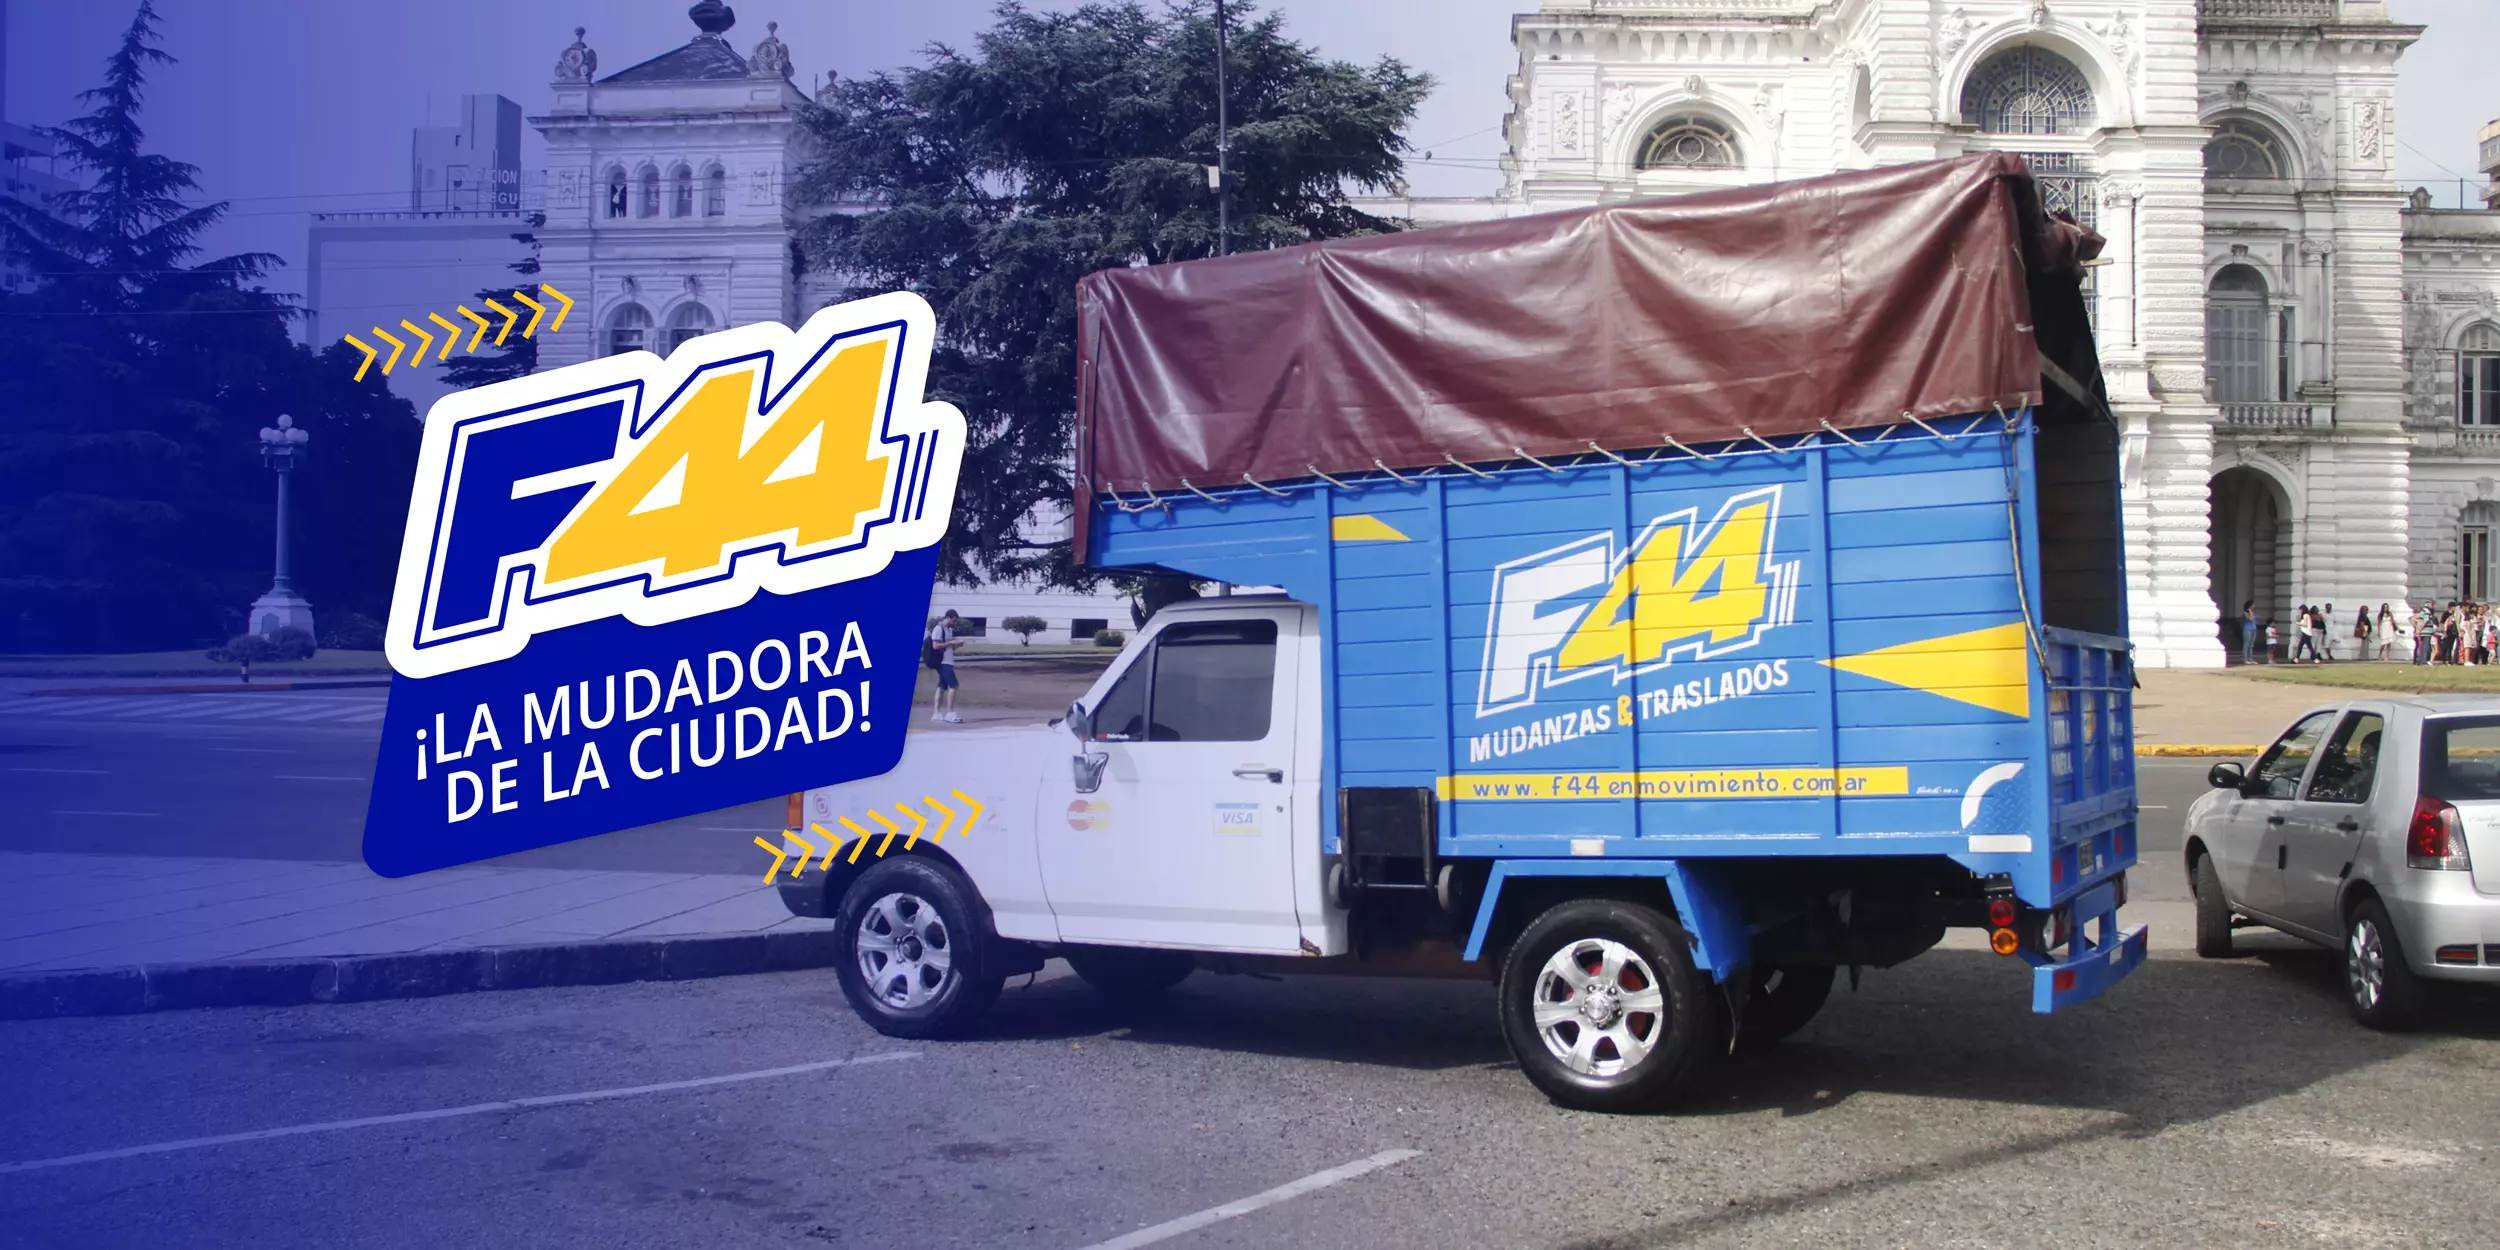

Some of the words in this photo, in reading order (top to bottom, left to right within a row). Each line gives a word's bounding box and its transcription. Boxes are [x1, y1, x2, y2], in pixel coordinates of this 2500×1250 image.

[1487, 500, 1770, 703] F44
[1470, 705, 1612, 763] MUDANZAS
[1617, 695, 1634, 726] &
[1637, 658, 1789, 720] TRASLADOS
[1222, 811, 1254, 824] VISA
